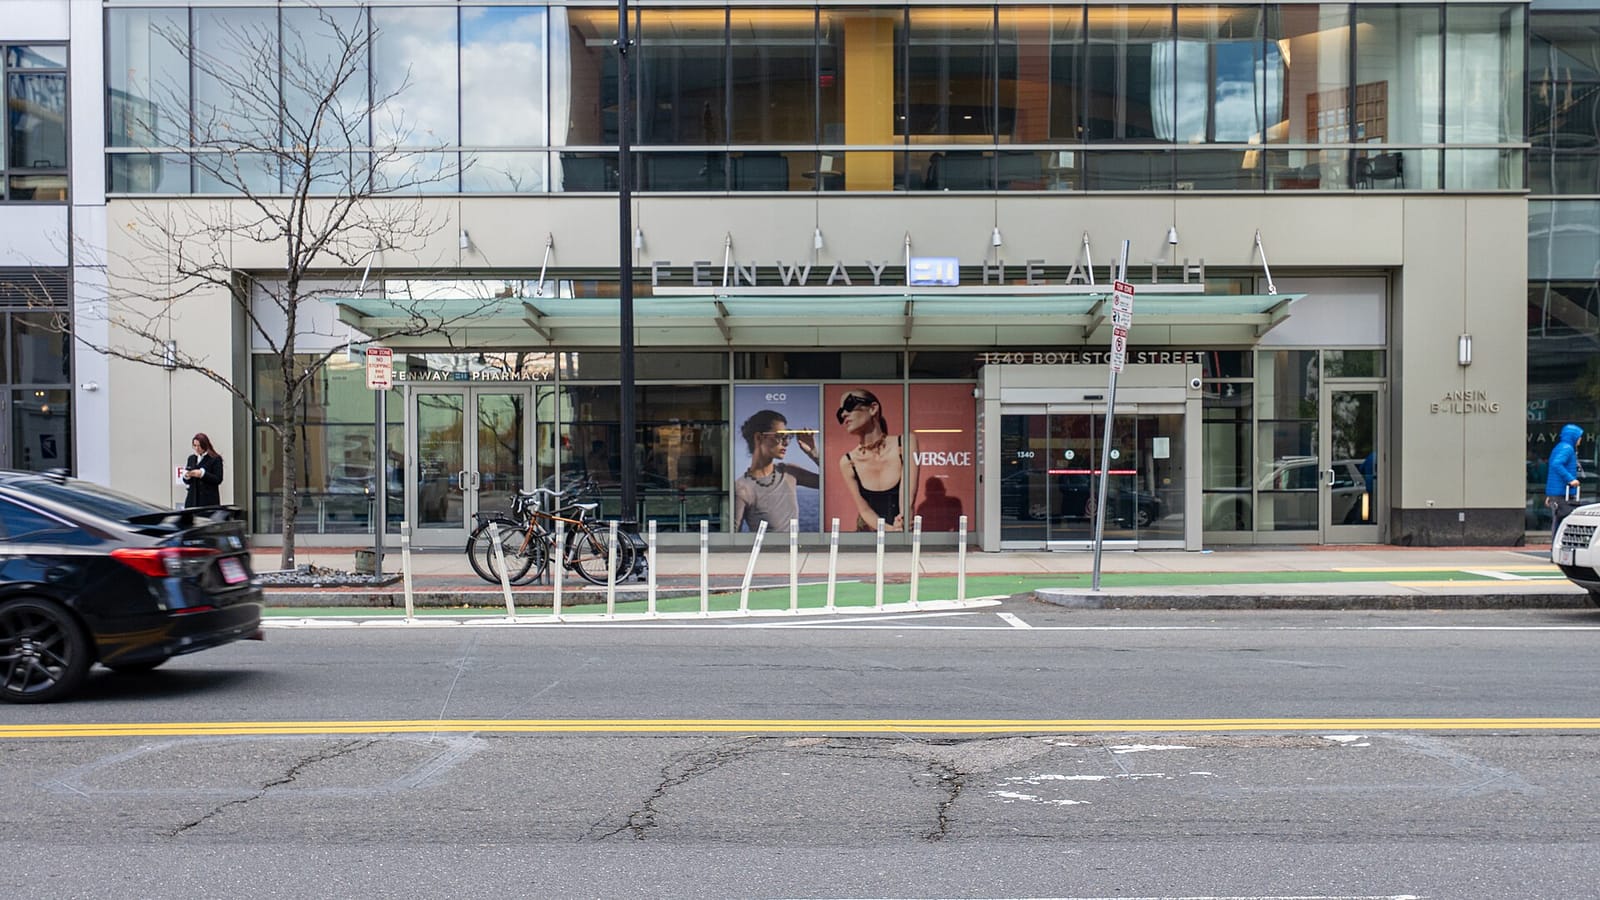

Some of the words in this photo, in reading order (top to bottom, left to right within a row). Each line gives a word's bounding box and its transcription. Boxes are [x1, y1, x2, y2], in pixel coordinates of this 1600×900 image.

[652, 261, 888, 286] FENWAY
[983, 258, 1204, 285] HEALTH
[984, 352, 1025, 364] 1340
[1137, 352, 1205, 364] STREET
[391, 371, 450, 381] FENWAY
[472, 371, 549, 381] PHARMACY
[765, 393, 787, 401] eco
[1441, 391, 1488, 401] ANSIN
[913, 451, 972, 466] VERSACE
